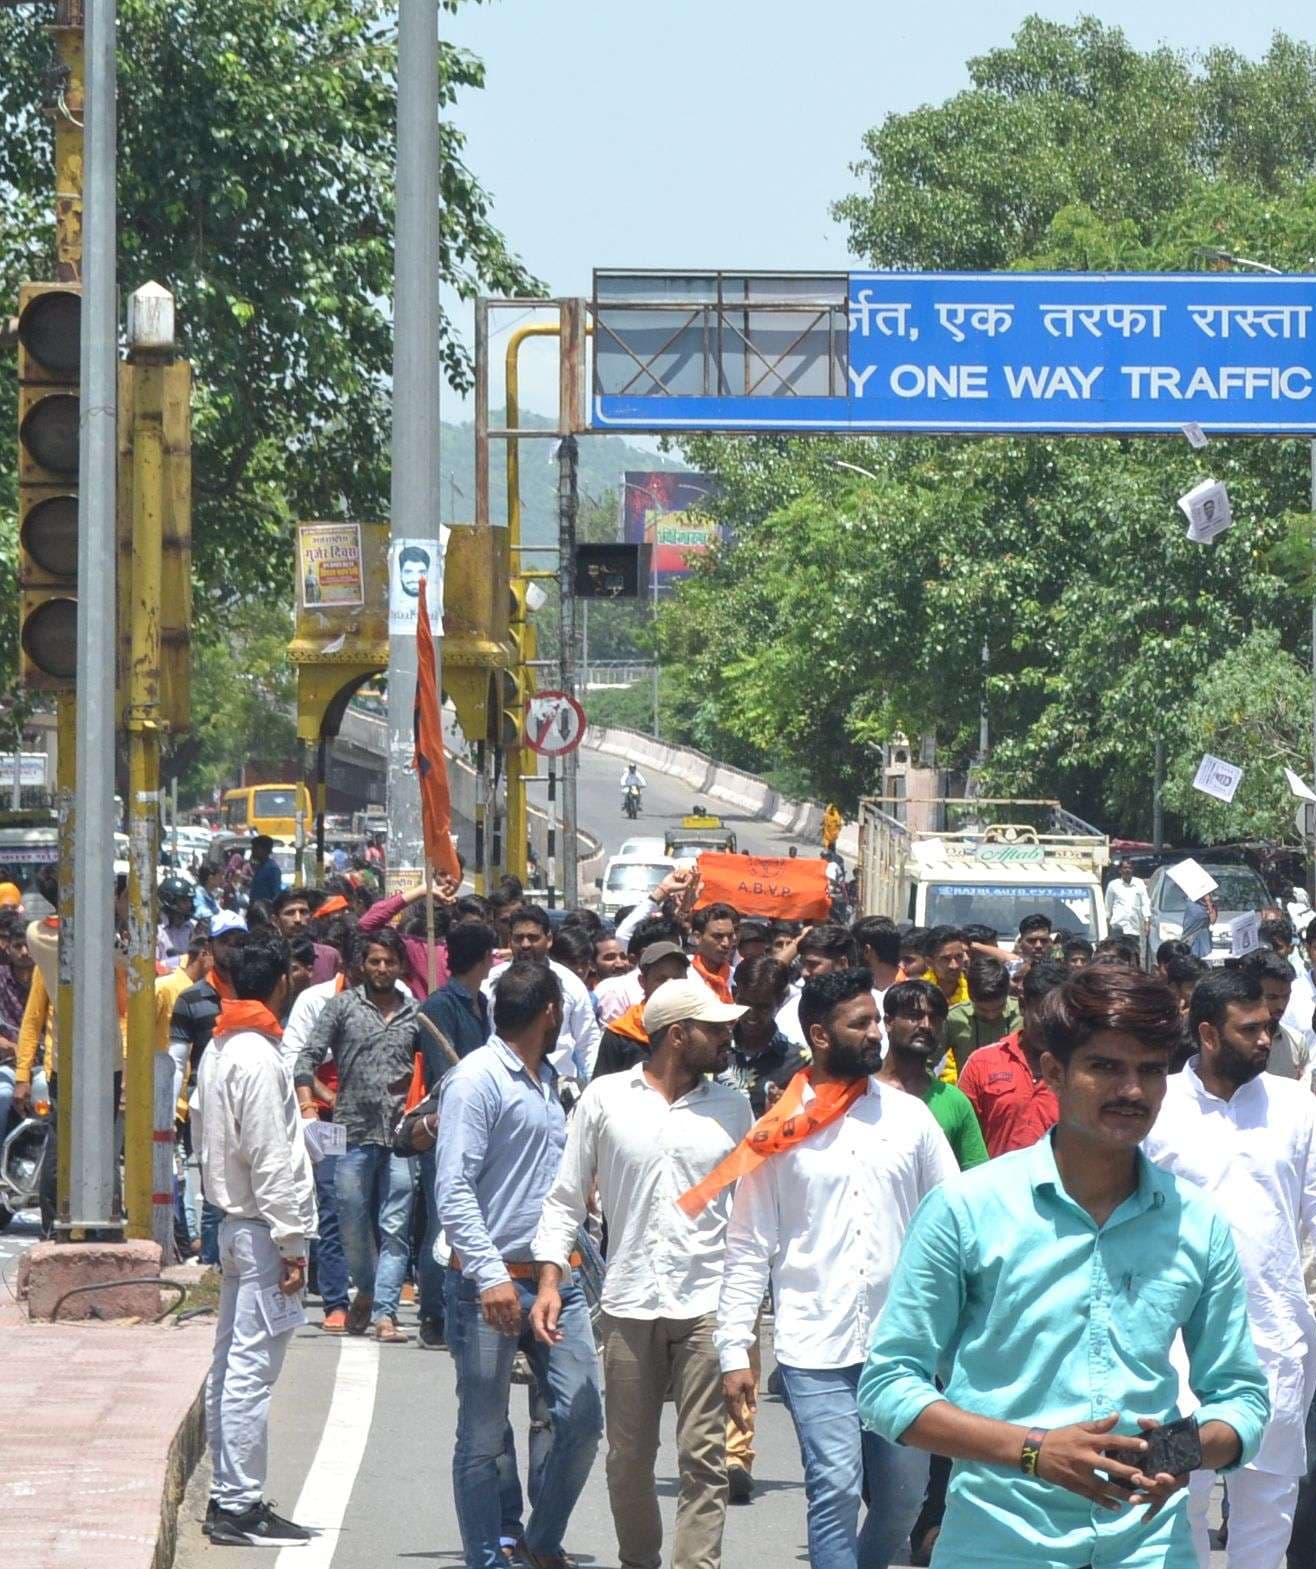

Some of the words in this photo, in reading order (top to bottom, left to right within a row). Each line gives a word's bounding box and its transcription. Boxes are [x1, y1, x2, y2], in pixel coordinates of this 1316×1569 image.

[934, 303, 1015, 342] एक
[1040, 304, 1167, 338] तरफा
[1187, 305, 1313, 338] रास्ता
[889, 364, 988, 398] ONE
[1003, 366, 1104, 399] WAY
[1121, 366, 1312, 399] TRAFFIC
[981, 847, 1040, 861] Aftab
